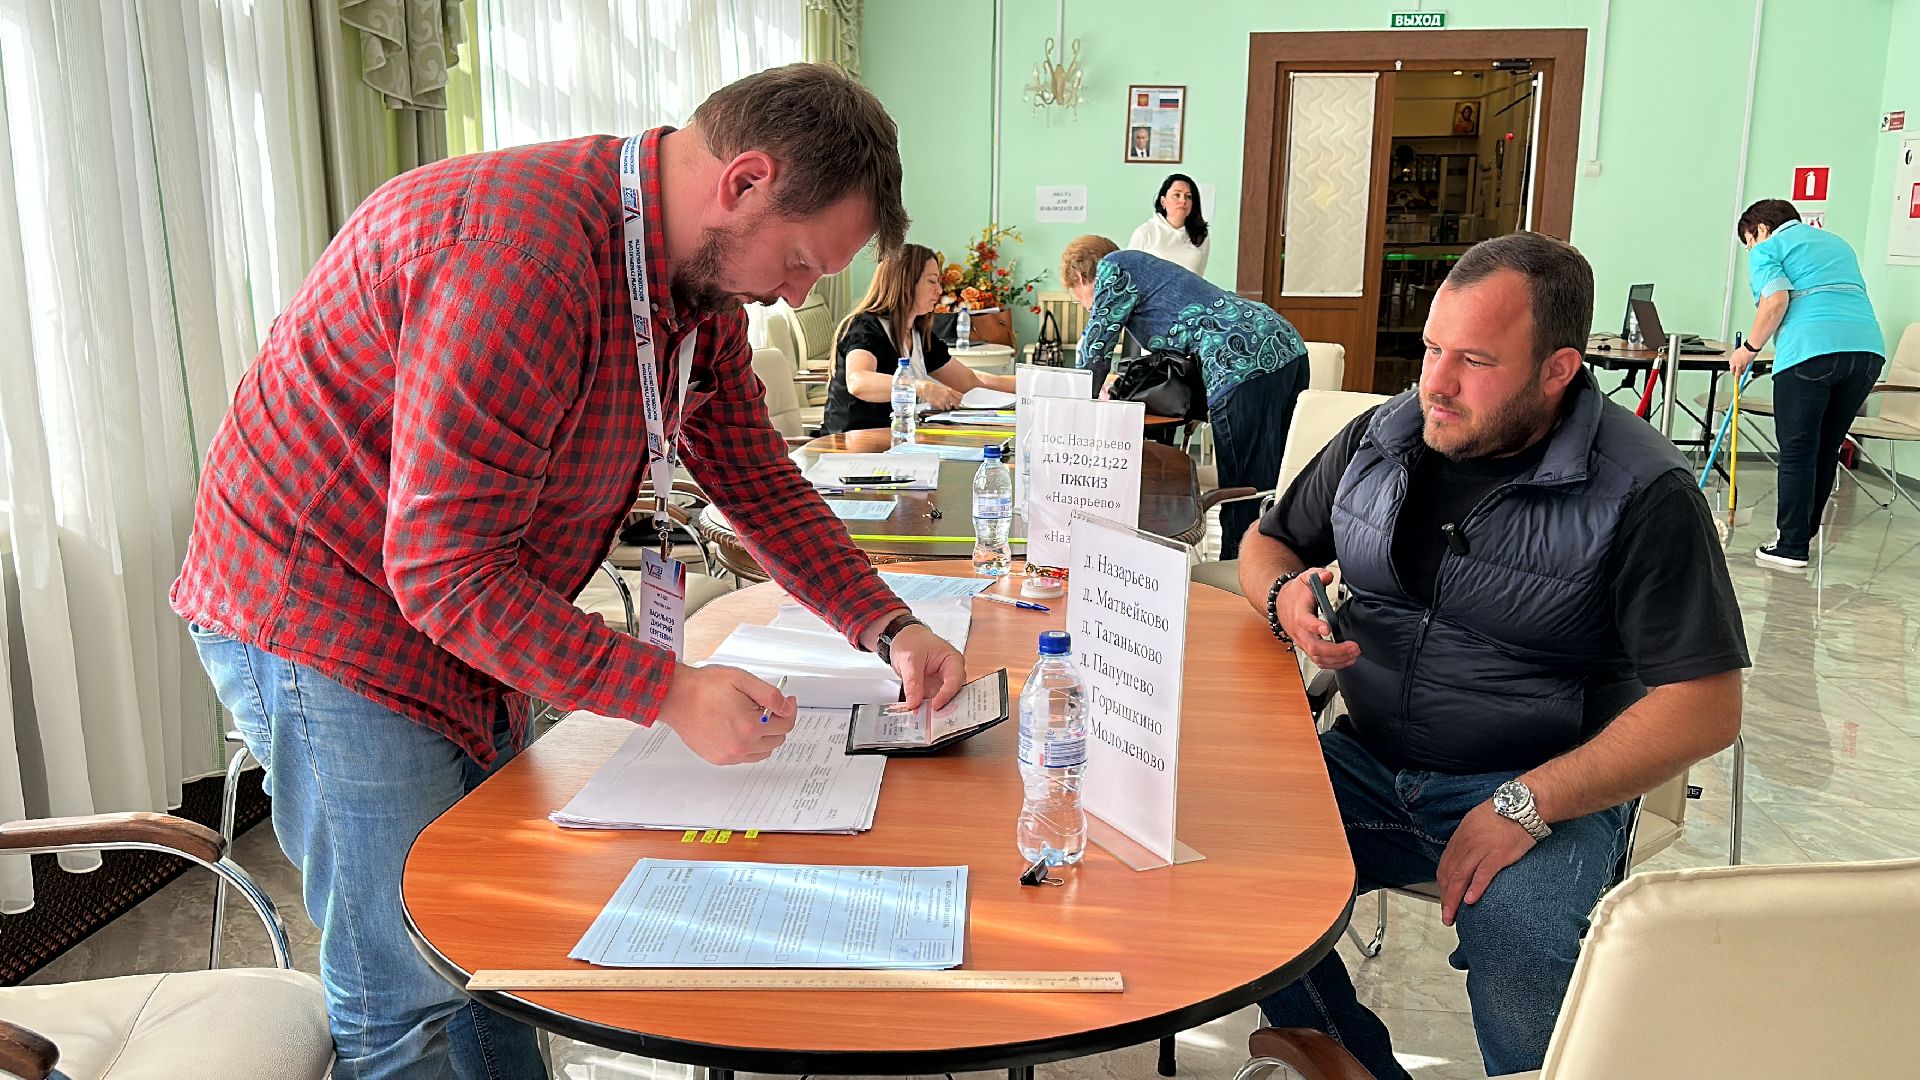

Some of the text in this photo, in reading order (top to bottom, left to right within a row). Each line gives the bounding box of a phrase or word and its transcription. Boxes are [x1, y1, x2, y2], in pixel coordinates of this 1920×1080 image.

[1395, 14, 1441, 27] ВЫХОД
[628, 240, 639, 301] ВЫБОРЫ ГУБЕРНАТОРА
[637, 266, 645, 302] МОСКОВСКОЙ
[1021, 397, 1032, 405] по
[1042, 433, 1132, 451] пос. Назарьево
[1042, 452, 1128, 470] д.19;20;21;22
[1060, 473, 1108, 489] ПЖКИЗ
[1045, 491, 1121, 508] «Назарьево»
[1044, 530, 1071, 544] «Наз
[1083, 554, 1159, 592] д. Назарьево
[1082, 587, 1169, 632] д. Матвейково
[1081, 619, 1163, 665] д. Таганьково
[1079, 652, 1154, 697] д. Папушево
[1091, 685, 1162, 736] Горышкино
[1090, 716, 1165, 772] Молоденово
